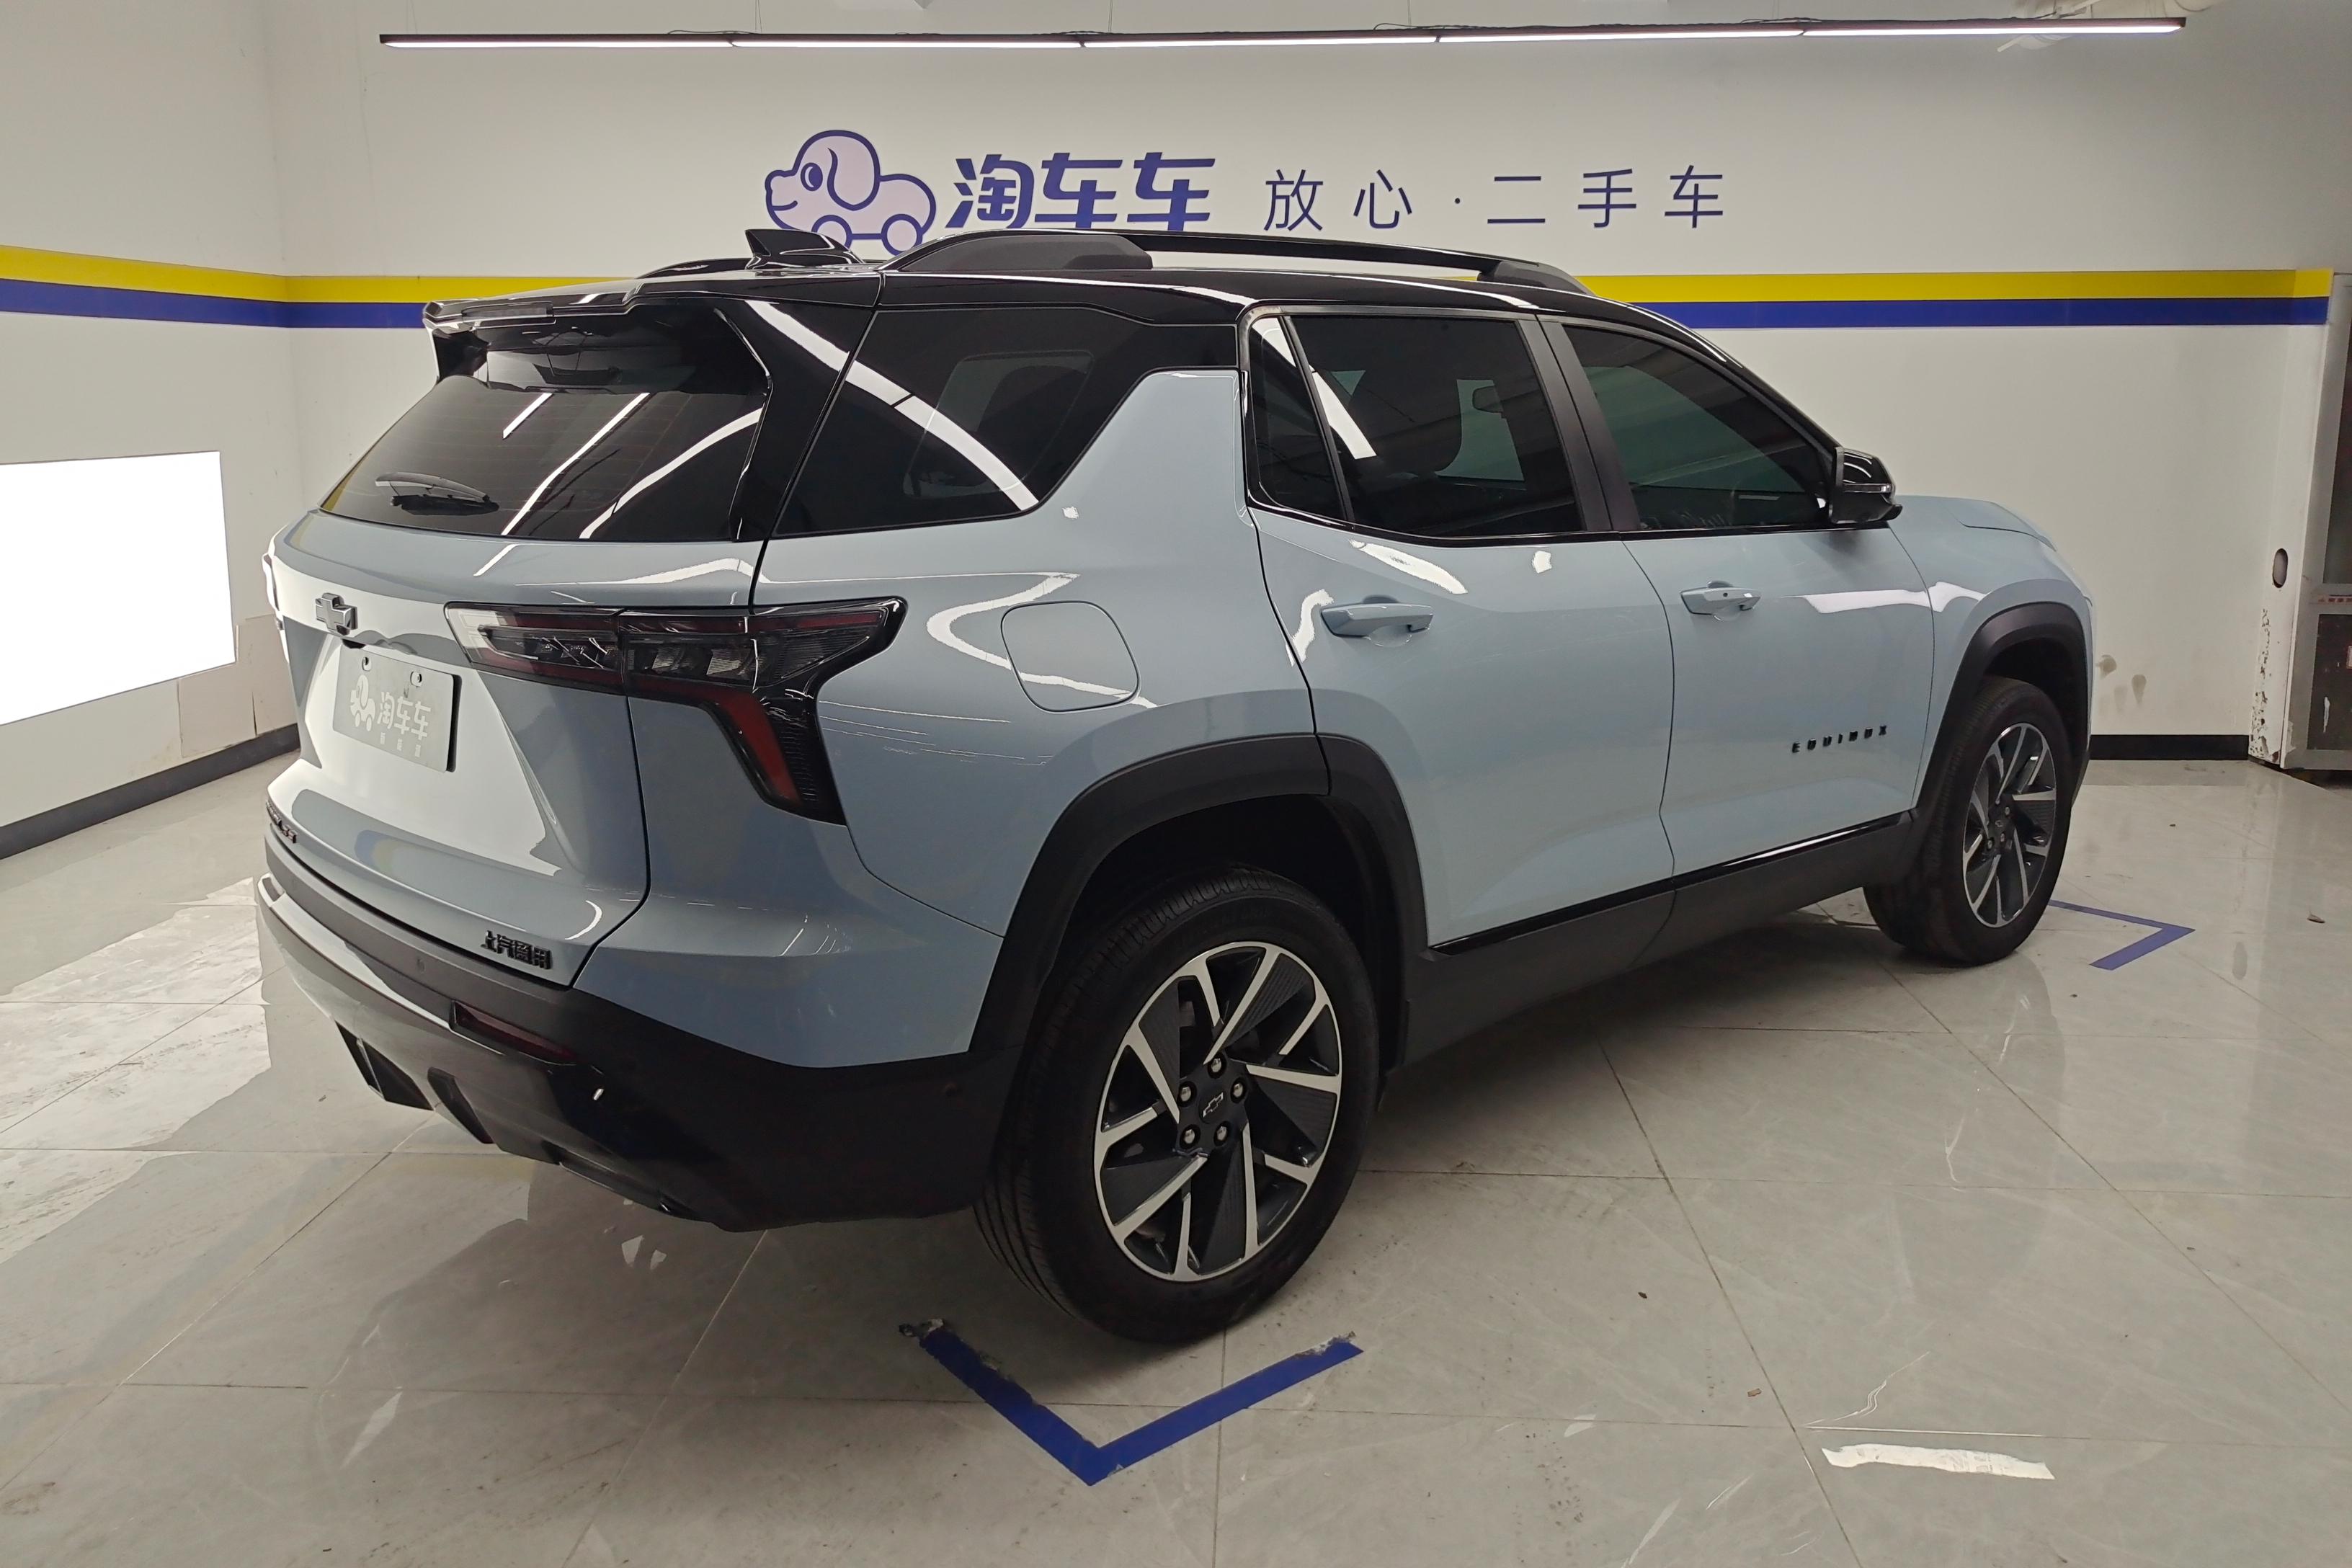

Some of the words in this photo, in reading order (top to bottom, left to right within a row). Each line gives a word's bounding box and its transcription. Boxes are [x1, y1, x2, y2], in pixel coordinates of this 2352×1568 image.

[945, 152, 1216, 231] 淘车车
[377, 691, 432, 741] 淘车车
[1791, 724, 1887, 754] EQUINOX
